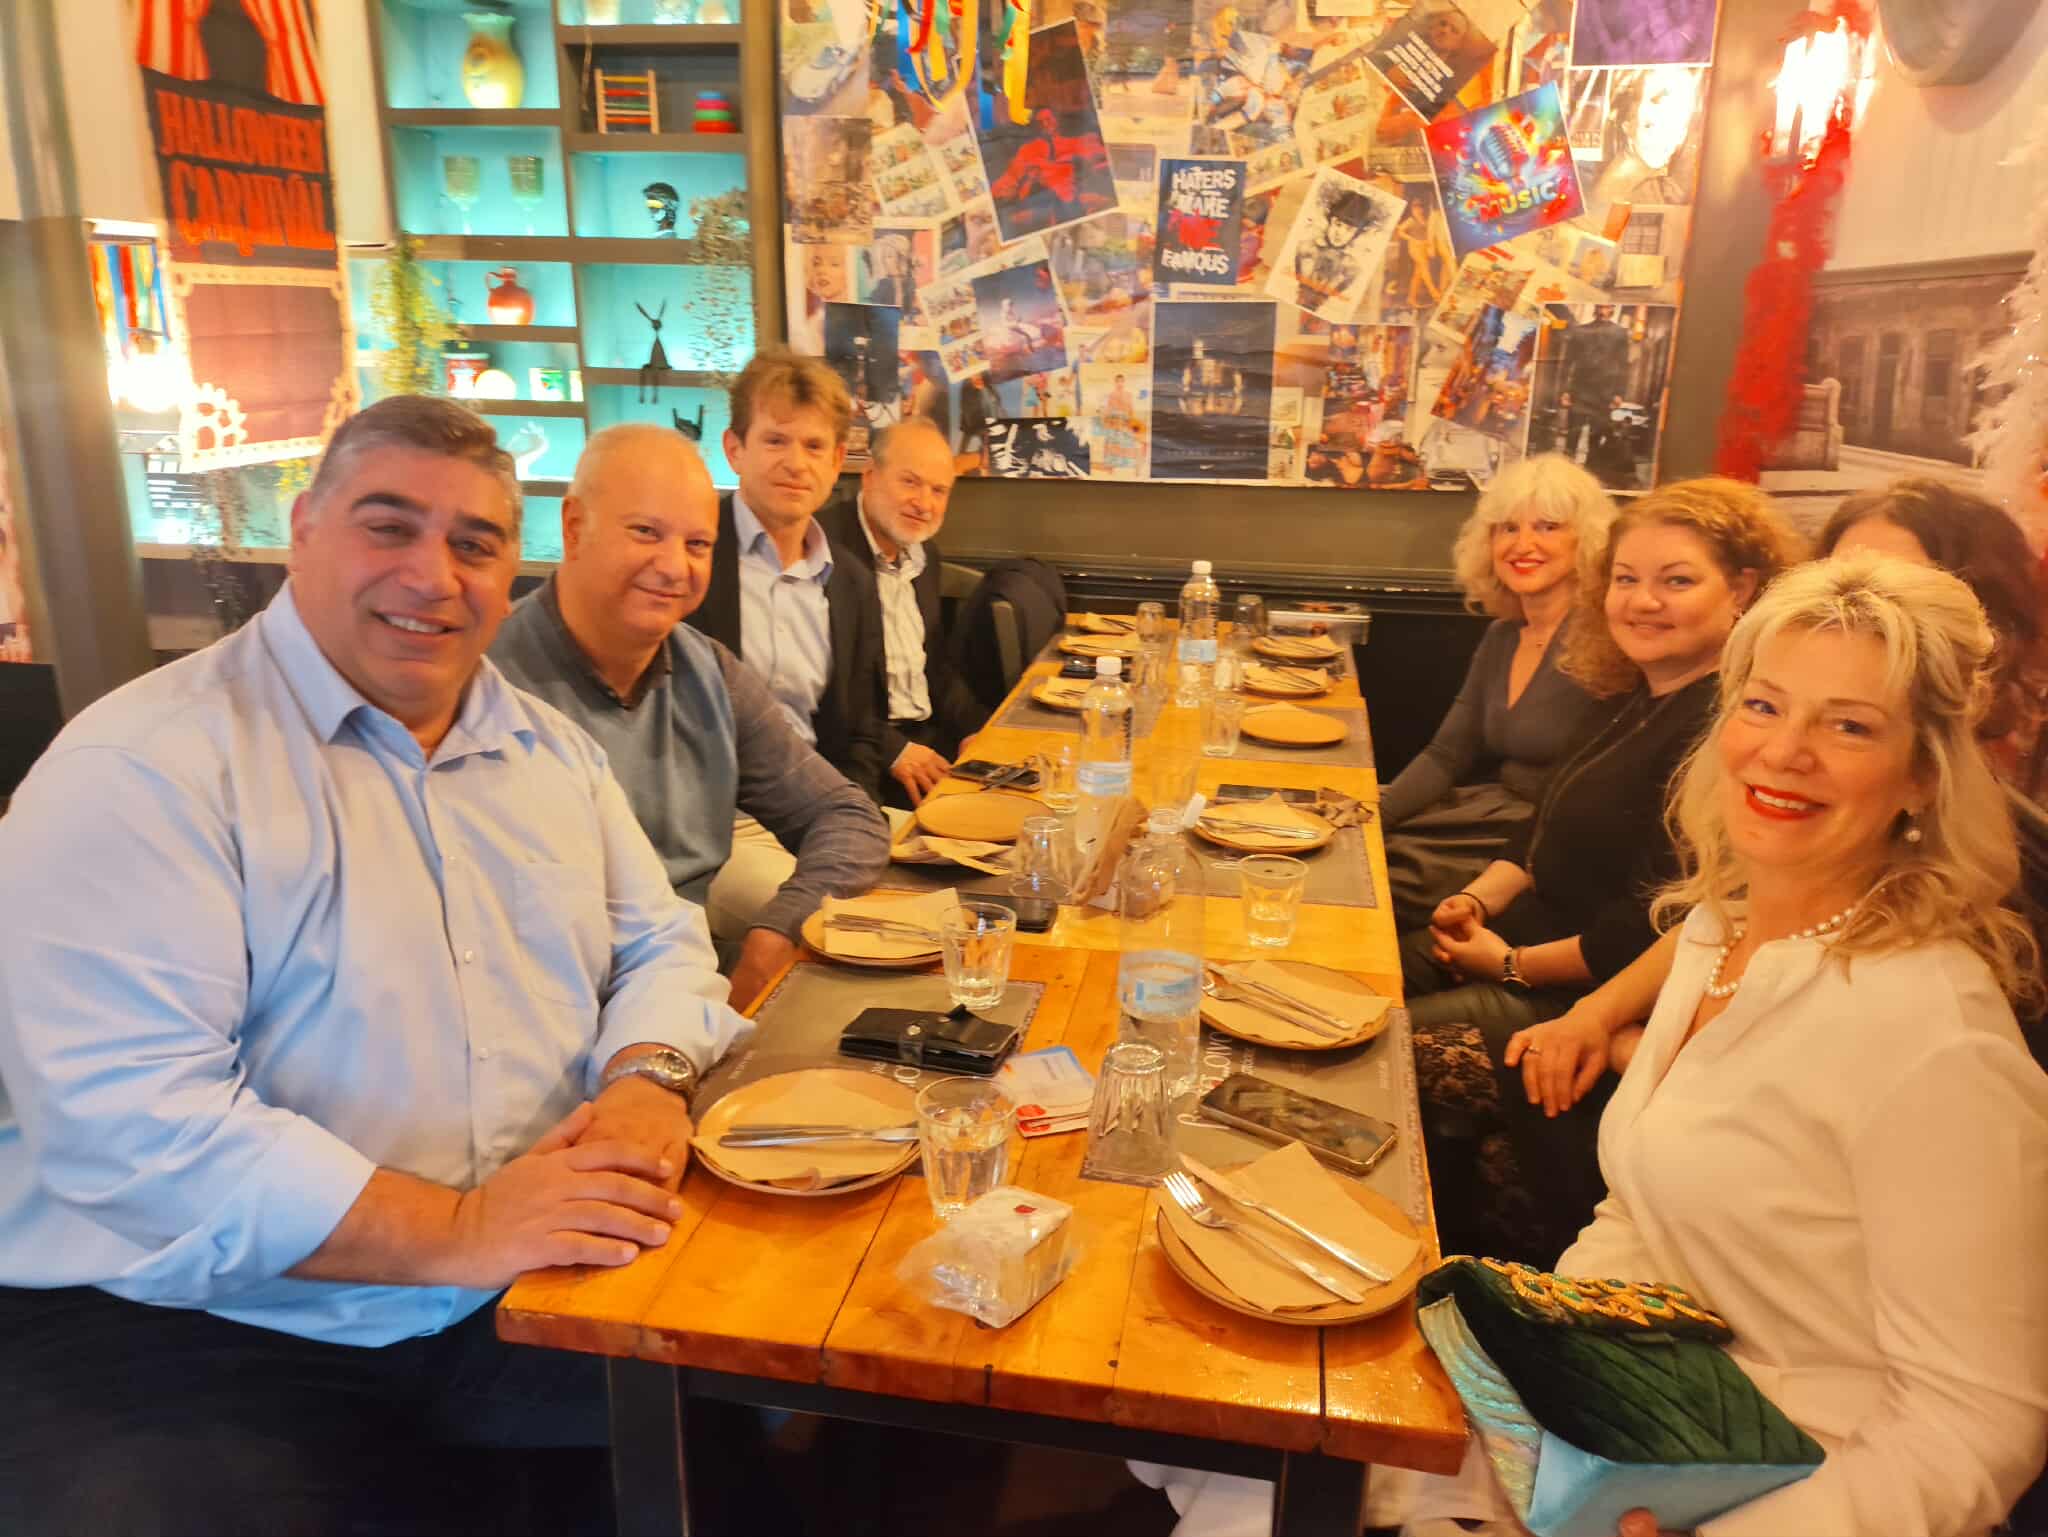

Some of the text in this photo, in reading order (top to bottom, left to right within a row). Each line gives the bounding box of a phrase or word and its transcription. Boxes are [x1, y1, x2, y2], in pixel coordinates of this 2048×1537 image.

[156, 89, 325, 173] HALLOWEEN
[1171, 166, 1237, 190] HATERS
[170, 161, 336, 256] CARNIVAL
[1479, 180, 1558, 223] MUSIC
[1161, 248, 1230, 275] FAMOUS
